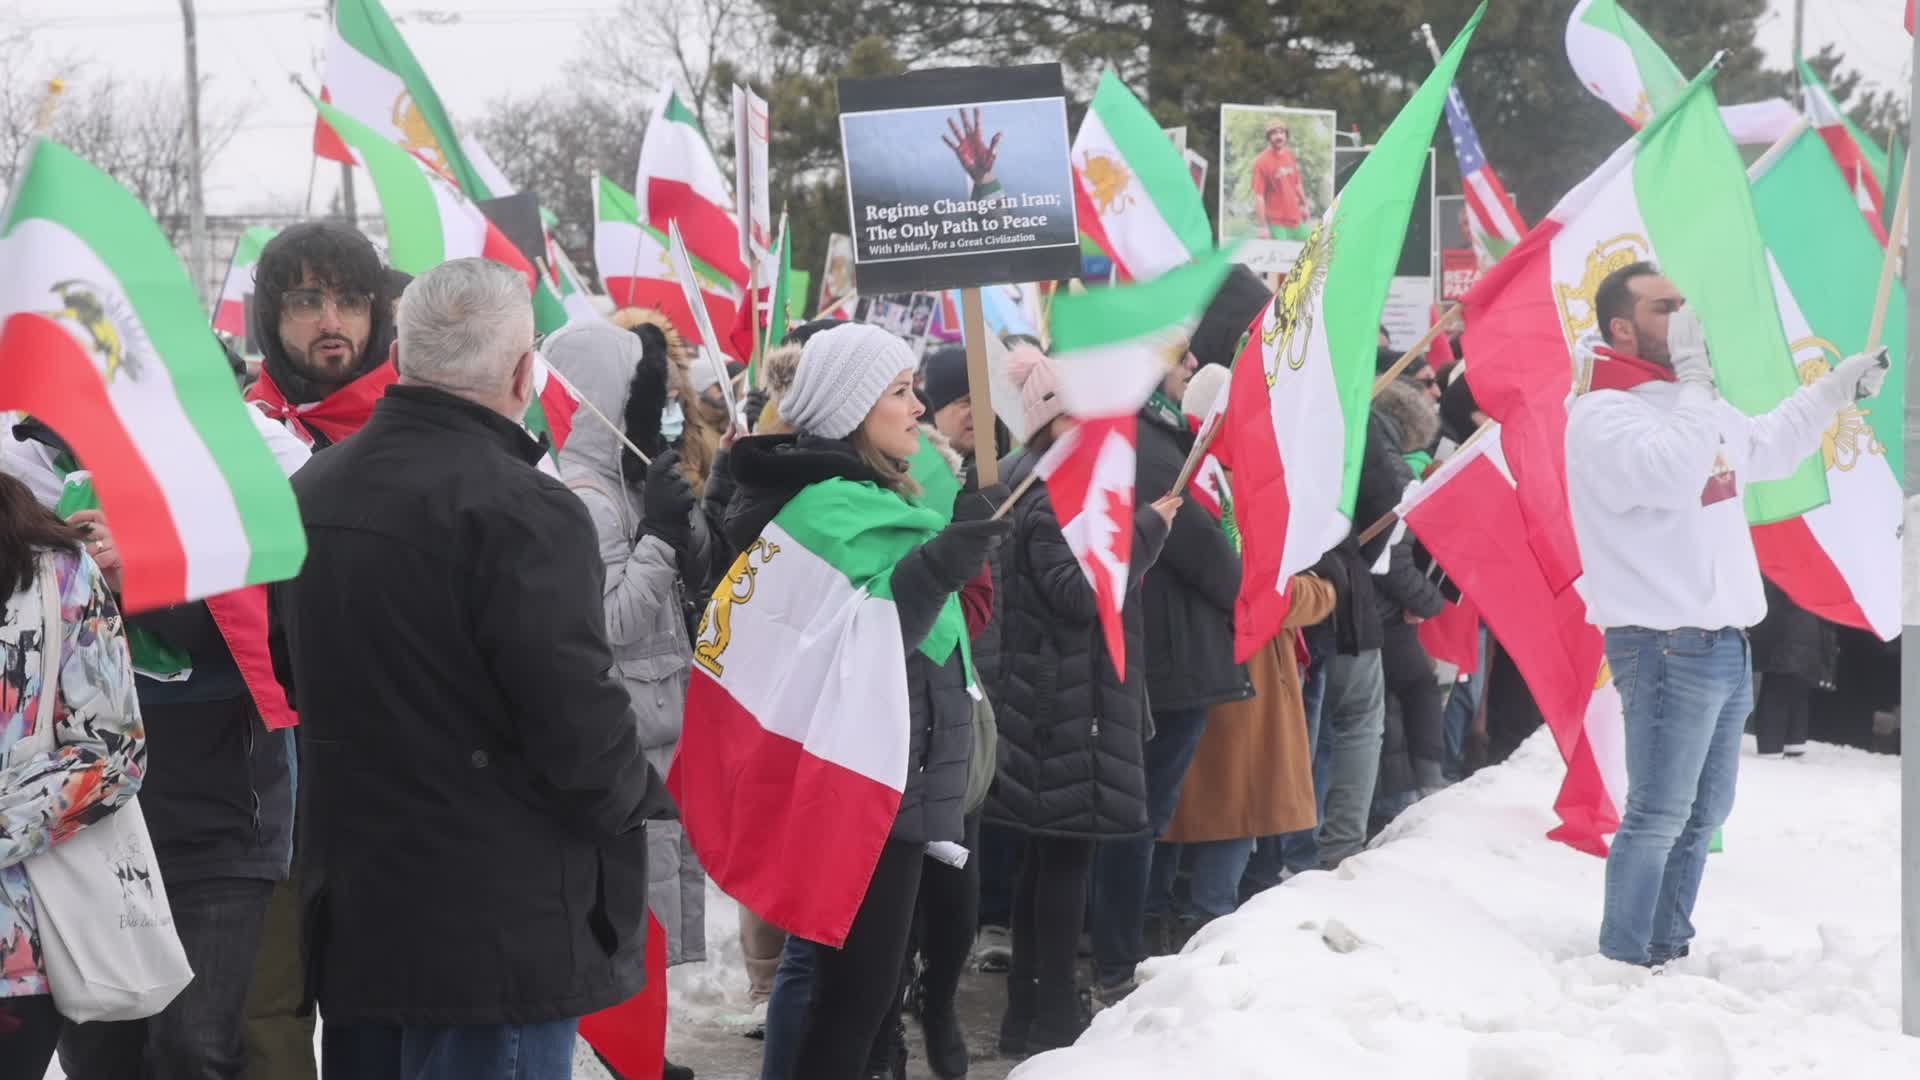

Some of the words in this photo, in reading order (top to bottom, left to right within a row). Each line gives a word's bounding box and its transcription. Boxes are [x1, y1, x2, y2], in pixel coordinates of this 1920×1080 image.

[865, 203, 929, 223] Regime
[933, 198, 997, 215] Change
[1001, 194, 1018, 208] in
[1021, 192, 1061, 208] Iran;
[866, 224, 897, 241] The
[900, 221, 939, 240] Only
[942, 217, 979, 235] Path
[982, 218, 999, 231] to
[1002, 215, 1048, 230] Peace
[869, 243, 892, 255] With
[894, 241, 931, 254] Pahlavi,
[932, 239, 948, 250] For
[949, 241, 956, 249] a
[957, 237, 983, 248] Great
